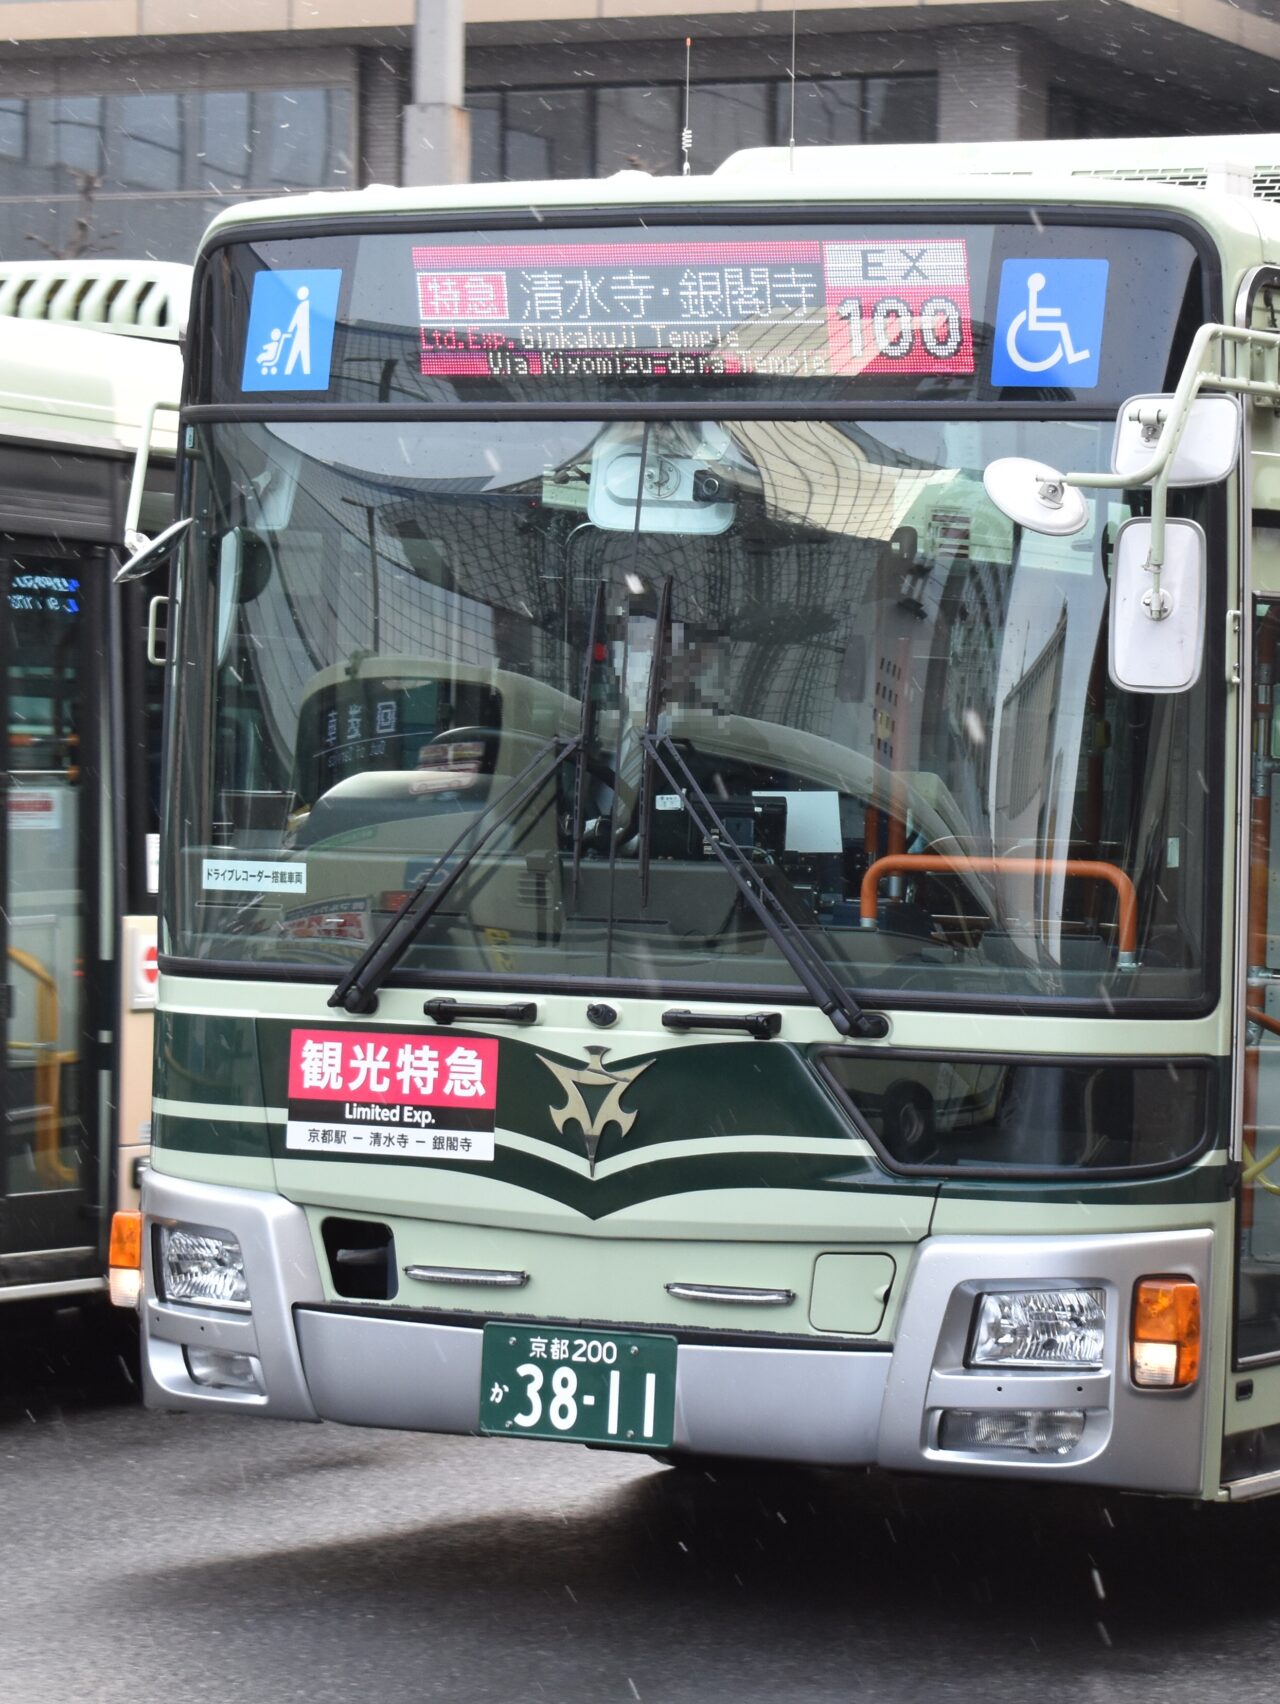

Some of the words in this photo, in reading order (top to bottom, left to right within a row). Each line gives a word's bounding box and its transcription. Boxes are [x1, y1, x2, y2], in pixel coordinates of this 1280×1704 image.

[861, 249, 929, 280] EX
[427, 276, 499, 315] 特急
[520, 325, 637, 349] Ginkakuji
[651, 323, 740, 348] Temple
[838, 297, 962, 358] 100
[488, 352, 531, 375] Via
[542, 350, 725, 375] Kiyomizu-dera
[736, 348, 826, 373] Temple
[300, 1039, 486, 1097] 観光特急
[344, 1102, 400, 1123] Limited
[403, 1106, 436, 1128] Exp.
[307, 1128, 347, 1145] 京都駅
[369, 1131, 410, 1148] 清水寺
[432, 1135, 473, 1152] 銀閣寺
[490, 1382, 510, 1404] か
[513, 1363, 656, 1438] 38-11
